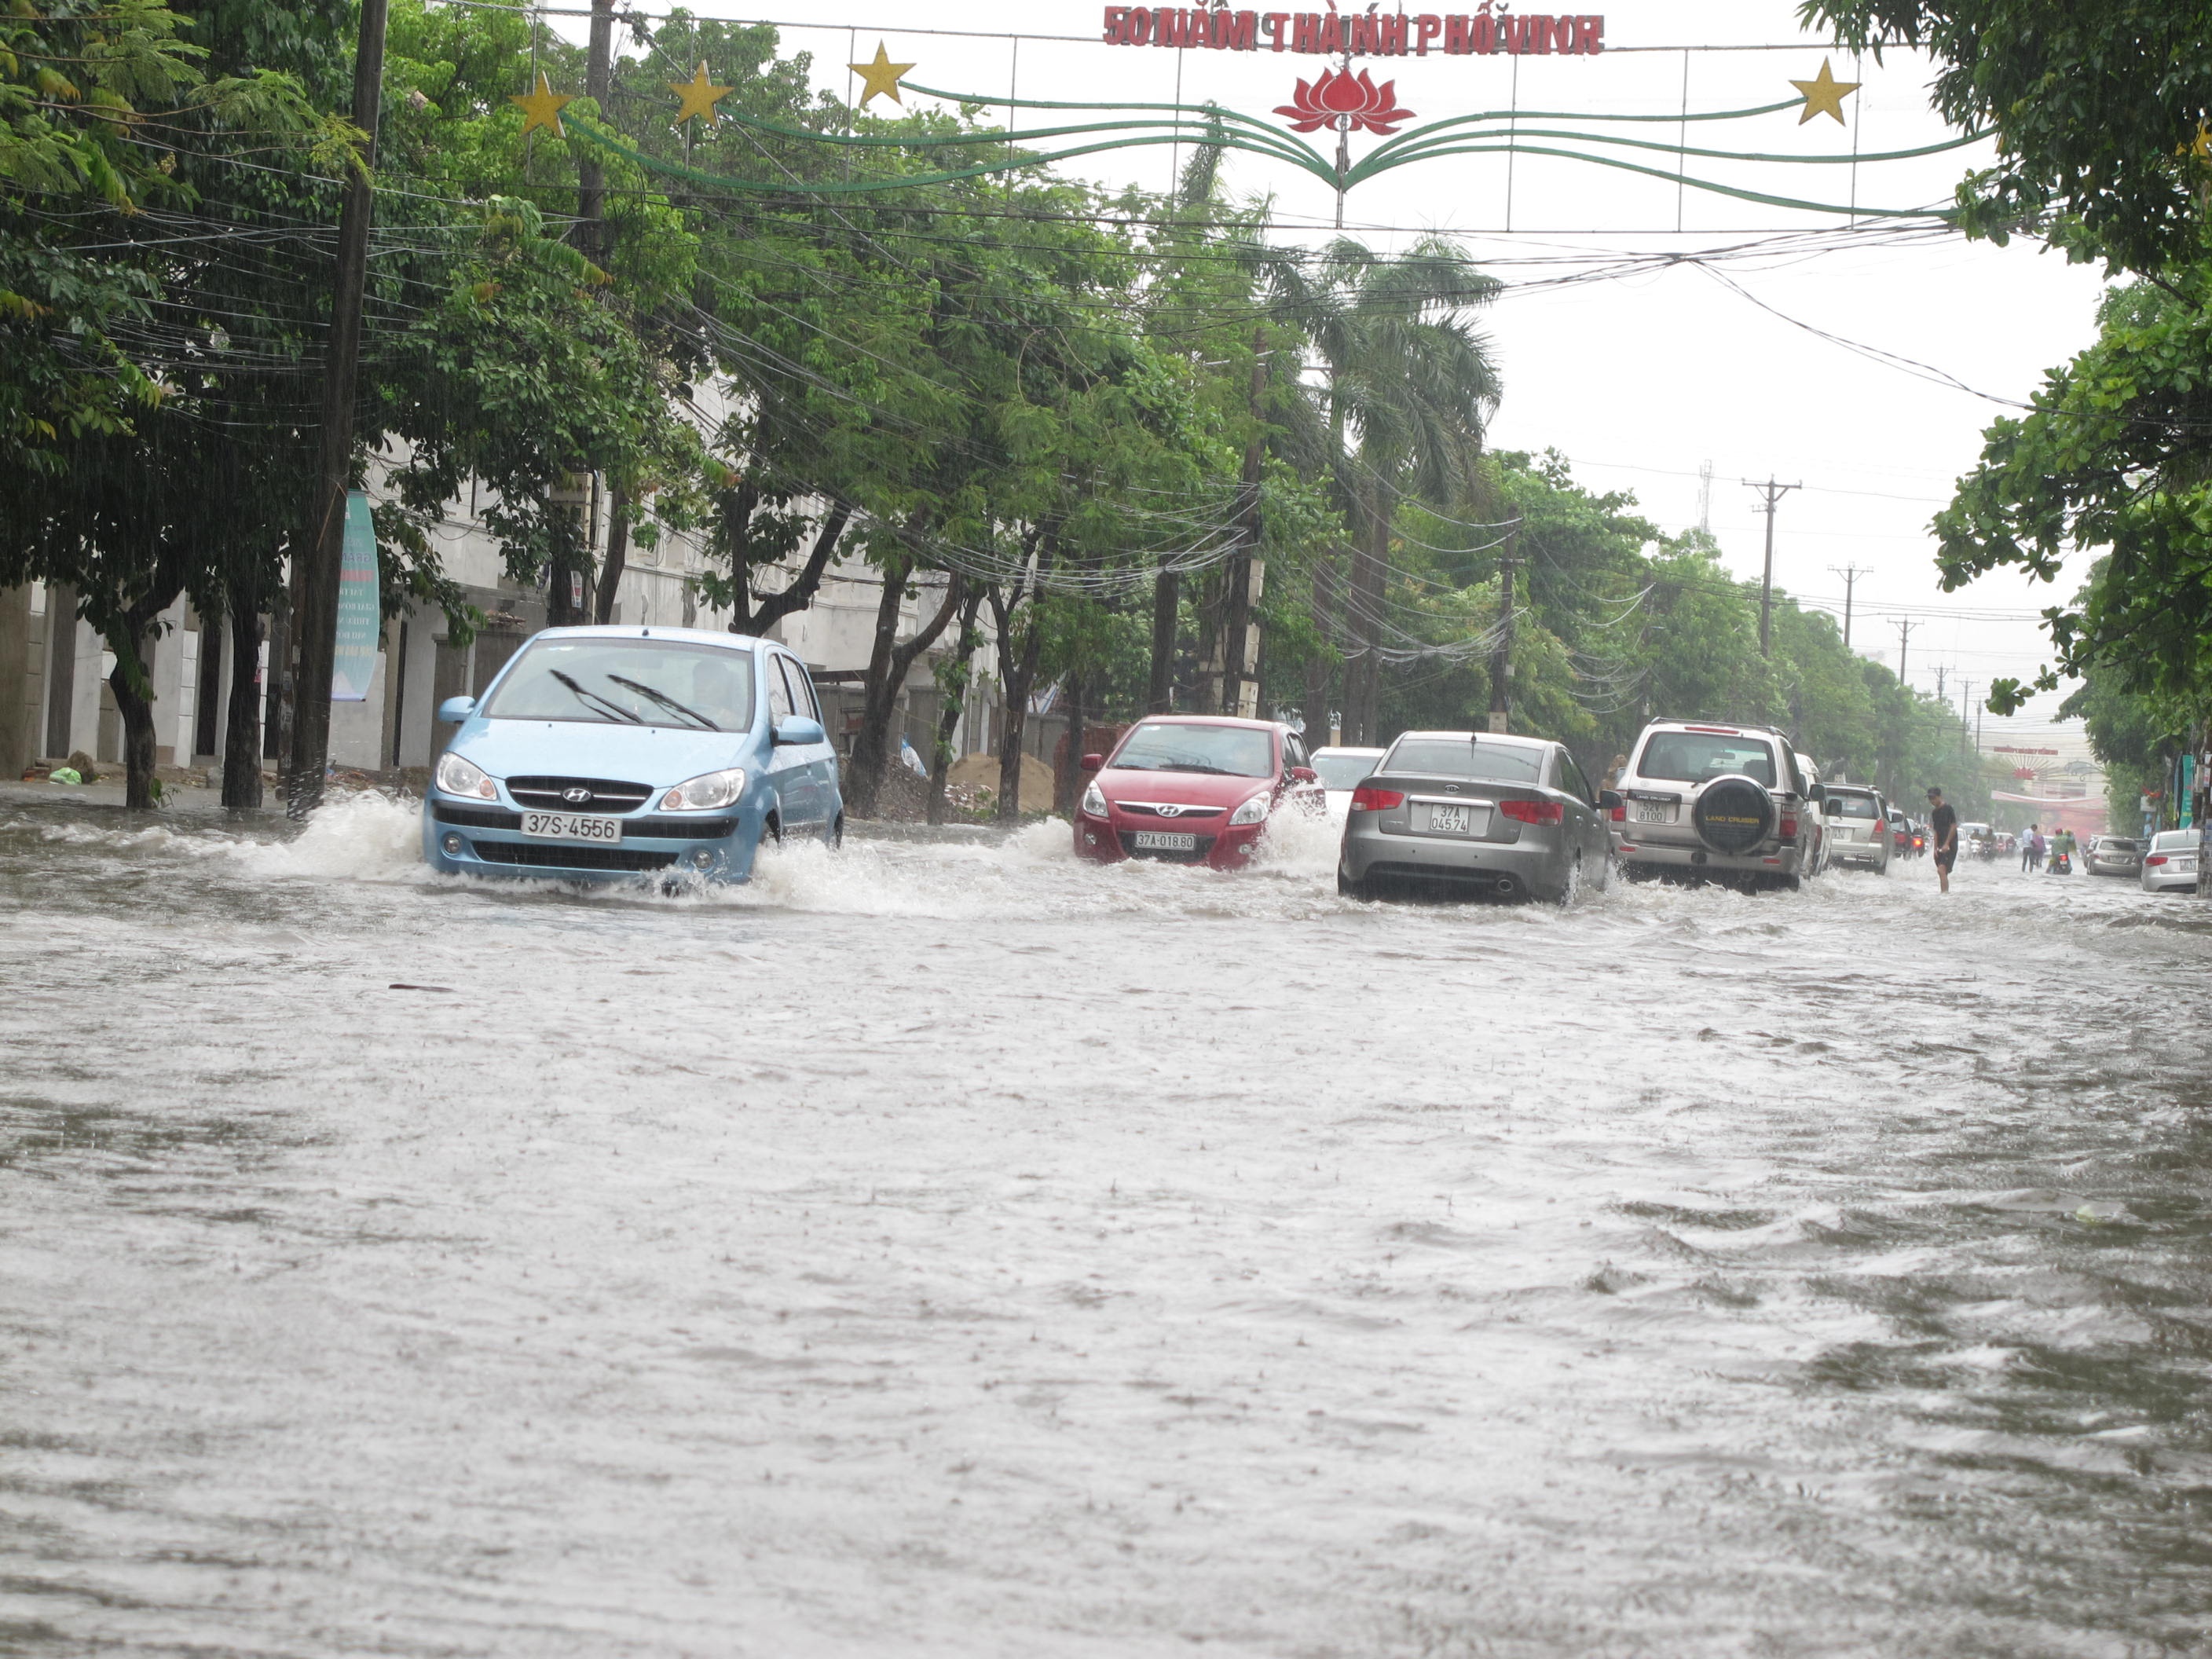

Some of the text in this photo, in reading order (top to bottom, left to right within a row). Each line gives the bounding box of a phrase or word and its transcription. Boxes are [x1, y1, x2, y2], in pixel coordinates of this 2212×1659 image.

[1103, 6, 1152, 46] 50
[1441, 806, 1460, 819] 37A
[1639, 811, 1663, 822] 8100
[1431, 818, 1467, 832] 045.74
